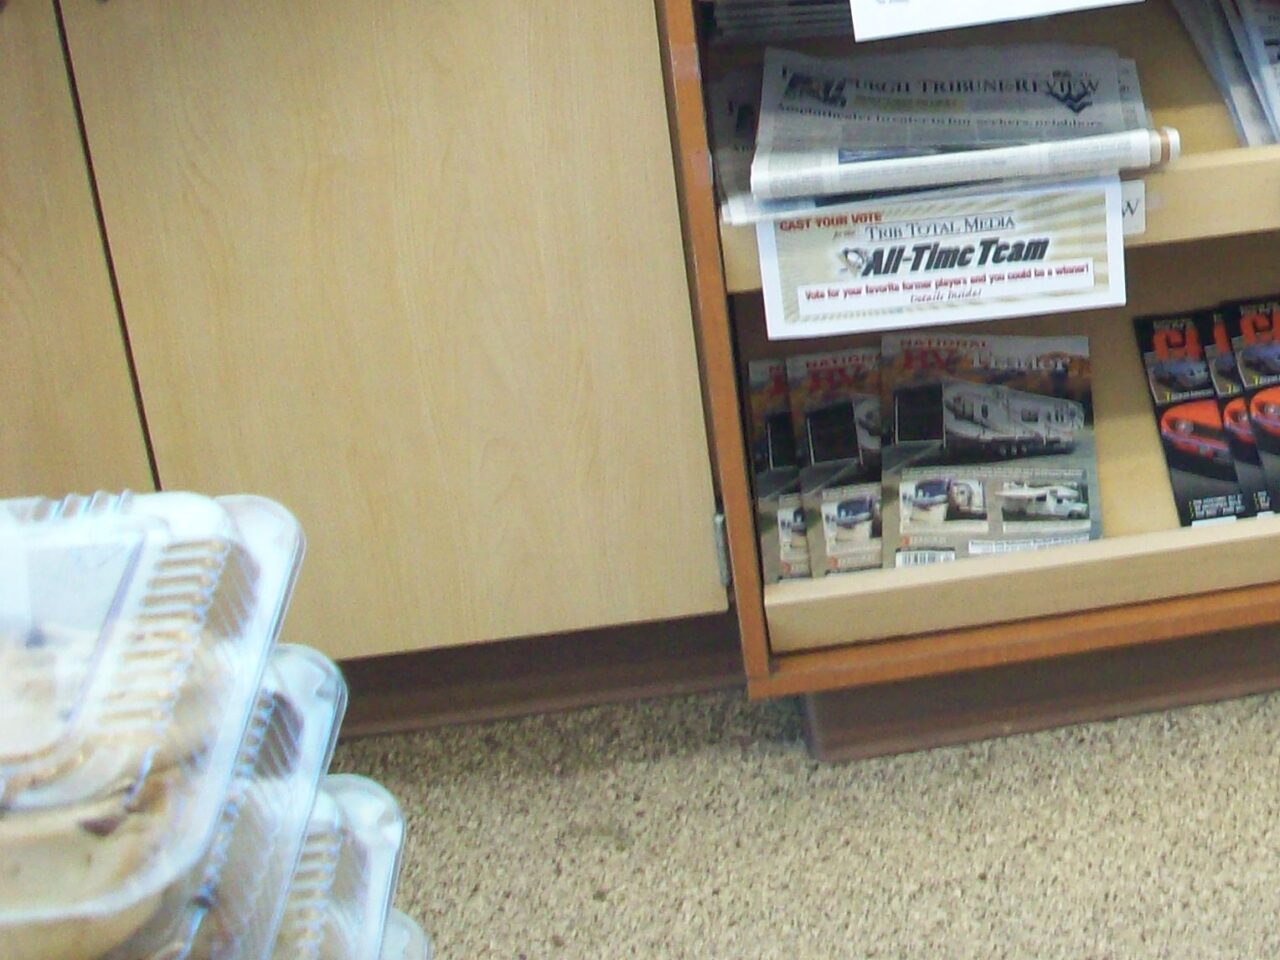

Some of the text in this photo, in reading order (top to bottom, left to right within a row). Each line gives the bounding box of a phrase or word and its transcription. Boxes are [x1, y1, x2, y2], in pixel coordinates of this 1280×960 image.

[779, 212, 882, 232] CAST YOUR VOTE
[865, 215, 1016, 241] TRIB TOTAL MEDIA
[861, 237, 1051, 277] All-Time Team
[805, 290, 825, 301] Vote
[827, 288, 840, 298] for
[843, 288, 862, 299] your
[865, 284, 900, 295] favorite
[902, 281, 932, 291] former
[935, 278, 967, 290] players
[970, 274, 987, 284] and
[989, 273, 1005, 285] you
[1007, 269, 1032, 281] could
[1034, 267, 1045, 277] be
